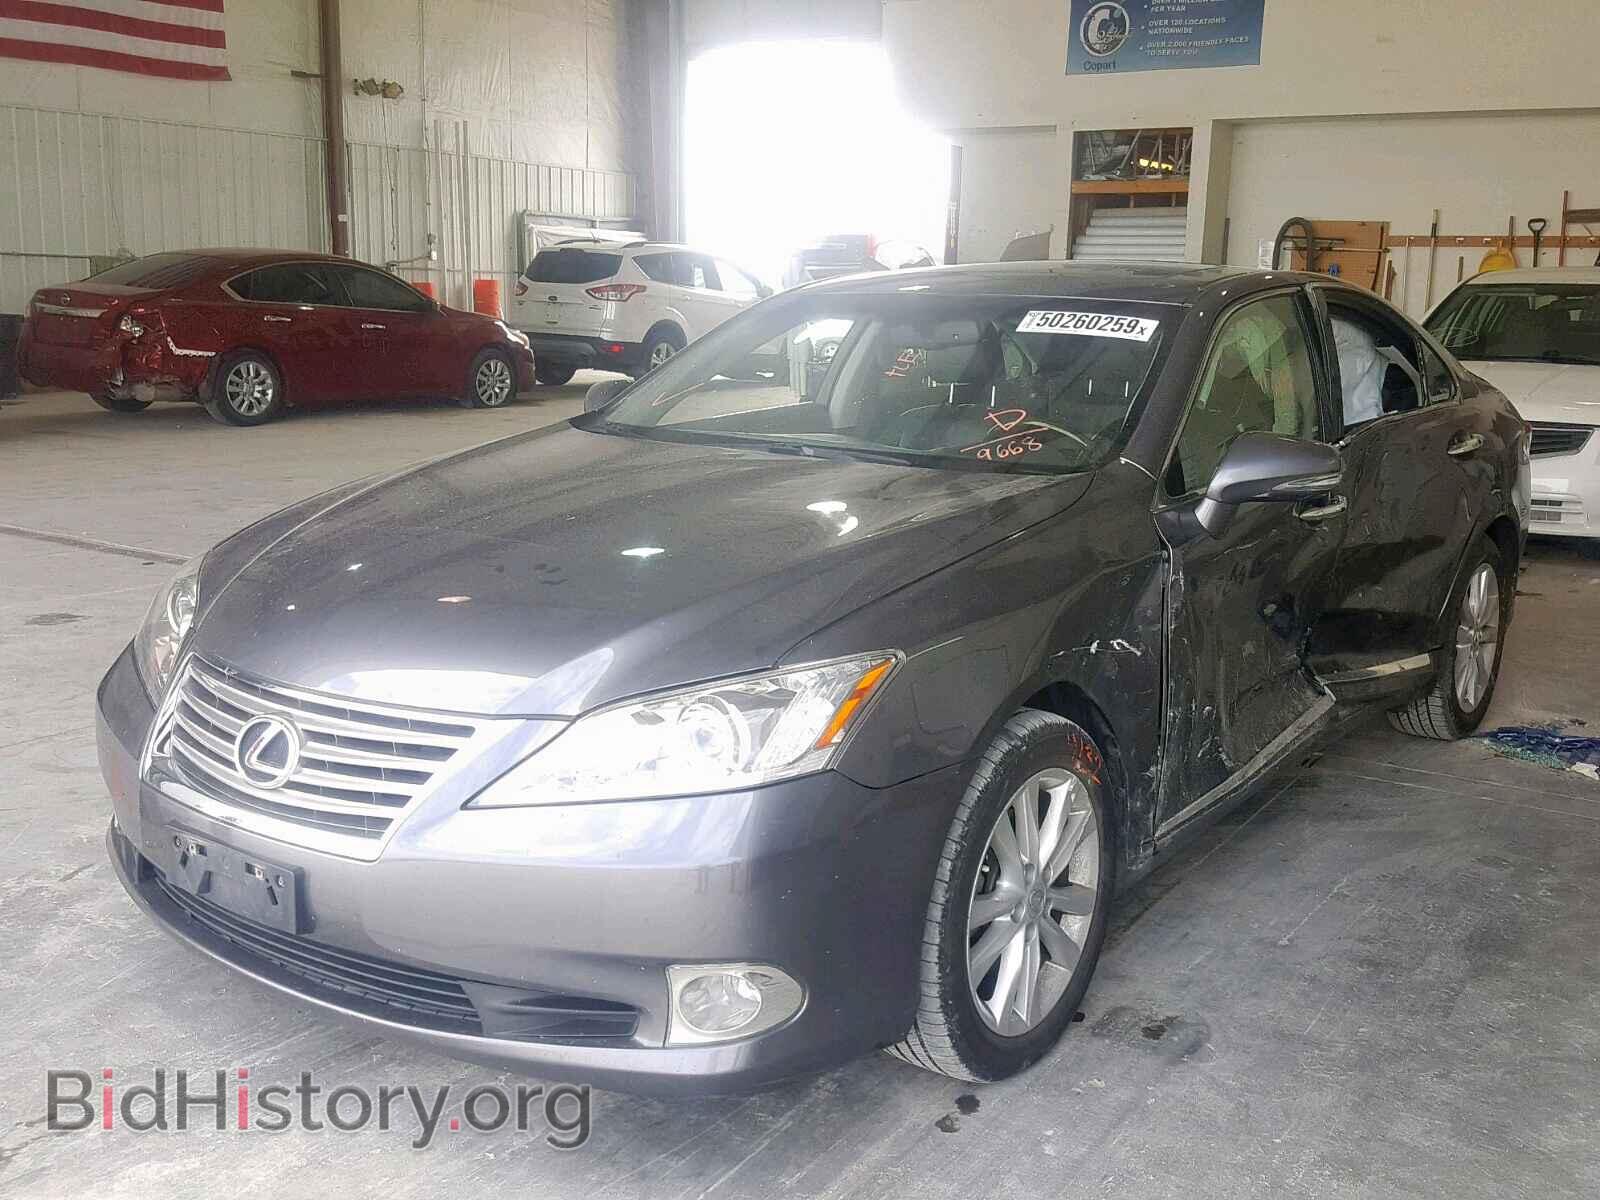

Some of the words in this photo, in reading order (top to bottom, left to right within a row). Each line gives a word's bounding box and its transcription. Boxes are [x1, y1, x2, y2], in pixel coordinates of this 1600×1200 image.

[1167, 4, 1186, 12] YEAR
[1148, 19, 1168, 27] OVER
[1184, 16, 1226, 25] LOCATIONS
[1148, 26, 1193, 35] NATIONWIDE
[1146, 40, 1166, 48] OVER
[1083, 60, 1117, 72] Copart
[976, 436, 1042, 461] 9668
